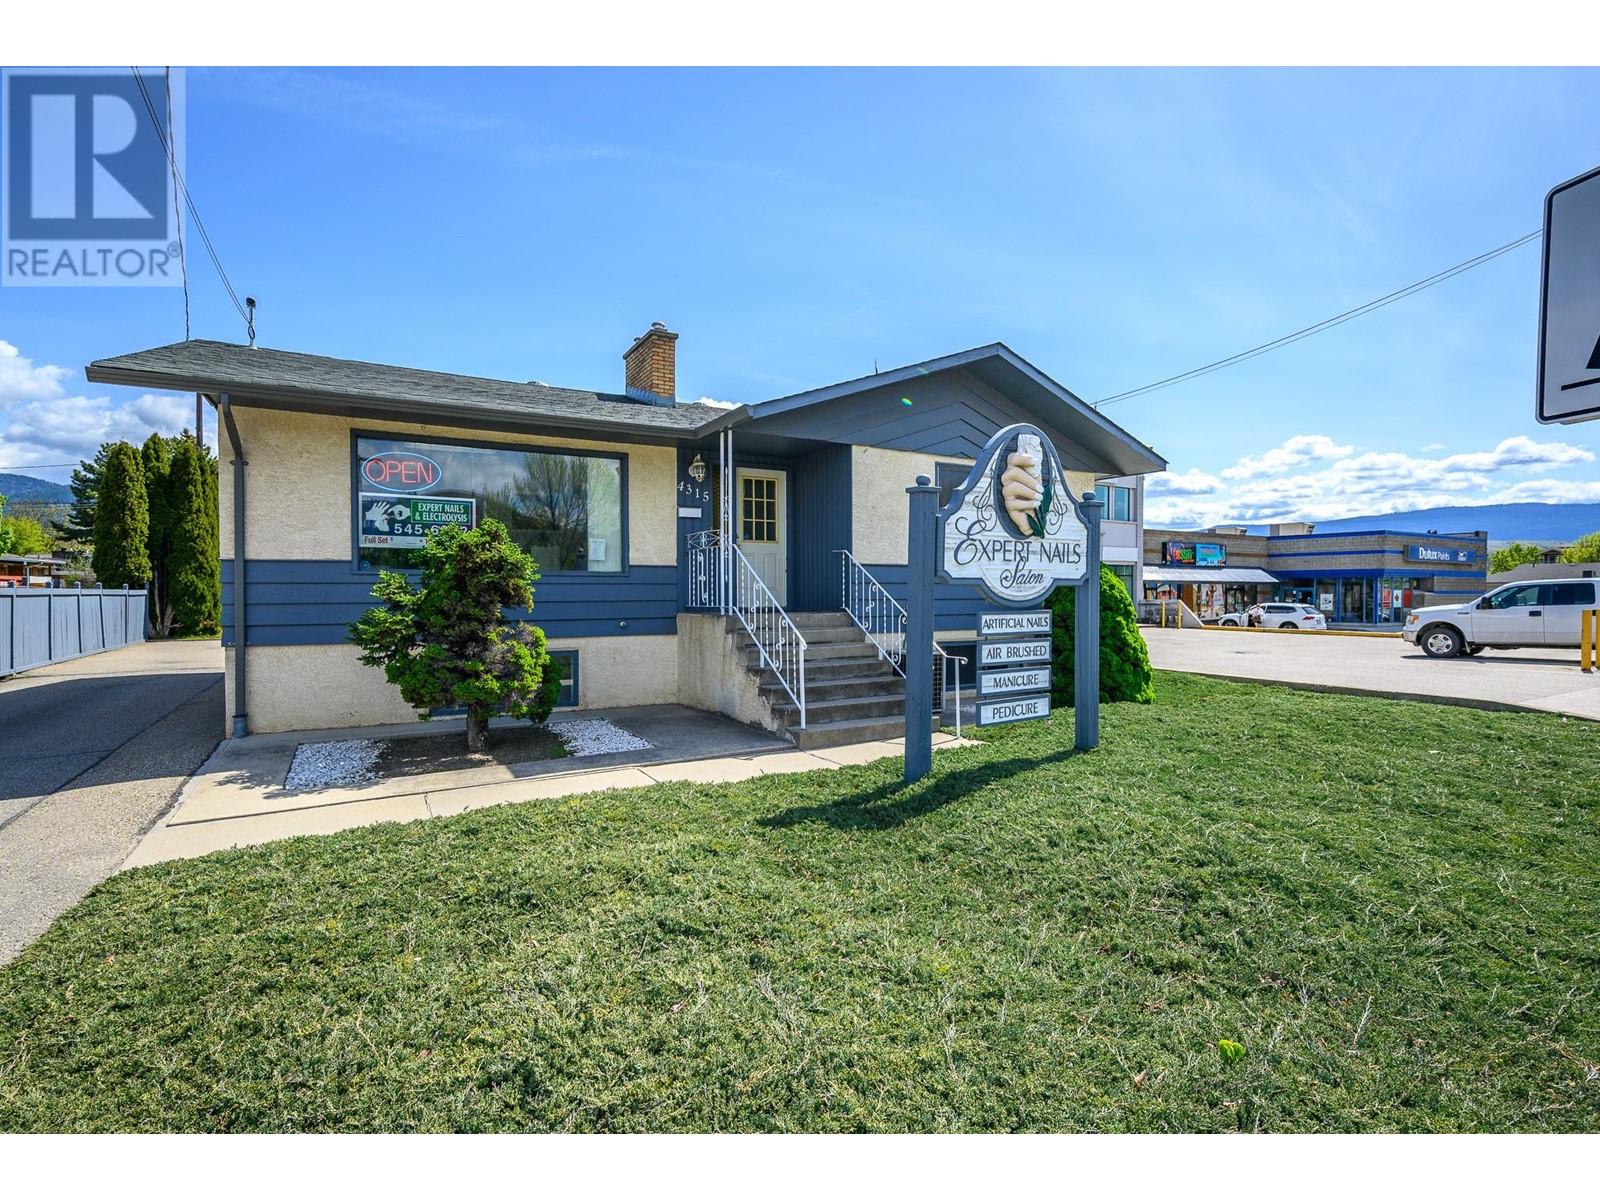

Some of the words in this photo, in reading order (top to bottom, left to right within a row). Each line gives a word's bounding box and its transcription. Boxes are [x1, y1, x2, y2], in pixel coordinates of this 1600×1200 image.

[365, 459, 433, 484] OPEN
[677, 480, 709, 502] 4315
[418, 502, 442, 512] EXPERT
[444, 503, 464, 513] NAILS
[422, 512, 468, 522] ELECTROLYSIS
[364, 536, 376, 544] Full
[377, 536, 388, 544] Set
[953, 517, 1033, 566] EXPERT
[1040, 541, 1082, 564] NAILS
[1419, 547, 1437, 560] Dulux
[1000, 555, 1044, 589] Salon
[982, 617, 1024, 630] ARTIFICIAL
[1026, 616, 1049, 628] NAILS
[986, 647, 1002, 660] AIR
[1006, 645, 1047, 658] BRUSHED
[993, 673, 1039, 689] MANICURE
[992, 702, 1039, 720] PEDICURE
